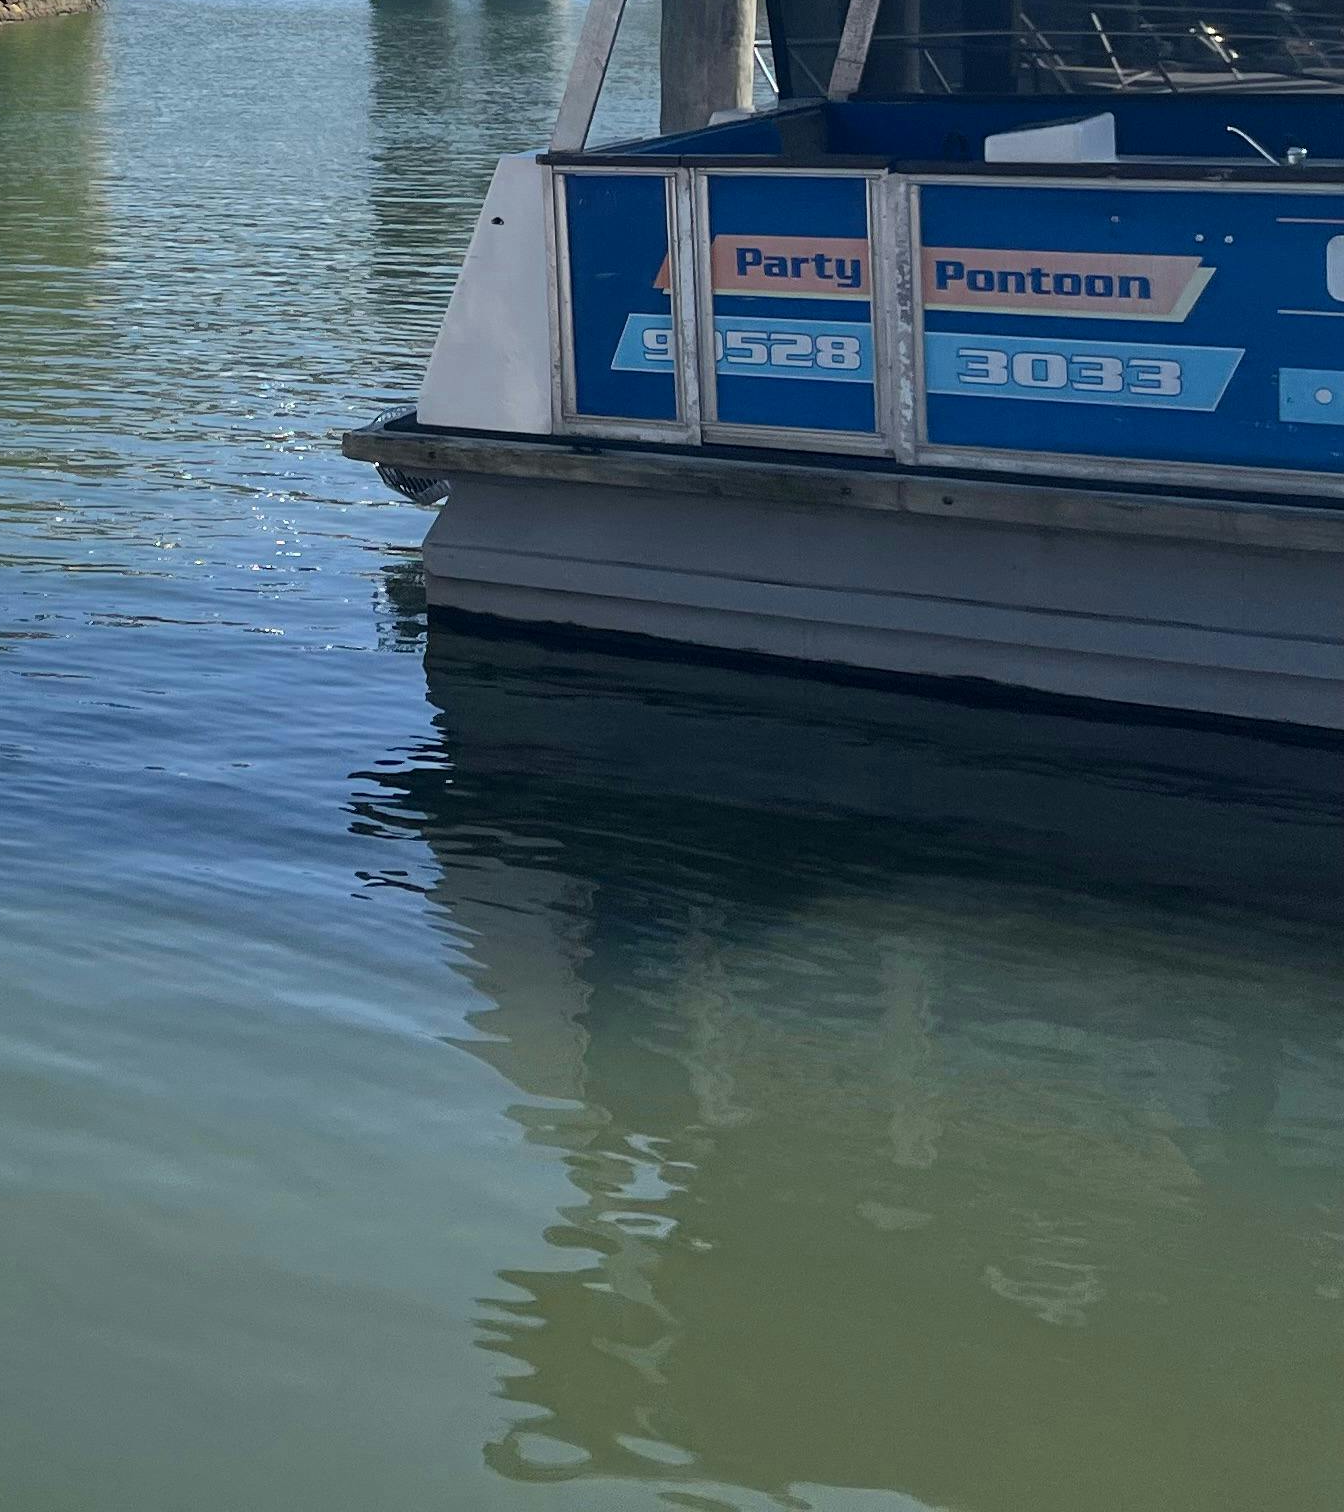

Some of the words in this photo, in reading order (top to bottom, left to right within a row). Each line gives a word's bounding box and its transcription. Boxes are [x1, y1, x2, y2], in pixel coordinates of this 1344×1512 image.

[735, 247, 862, 289] Party
[935, 260, 1152, 300] Pontoon
[958, 348, 1183, 396] 3033
